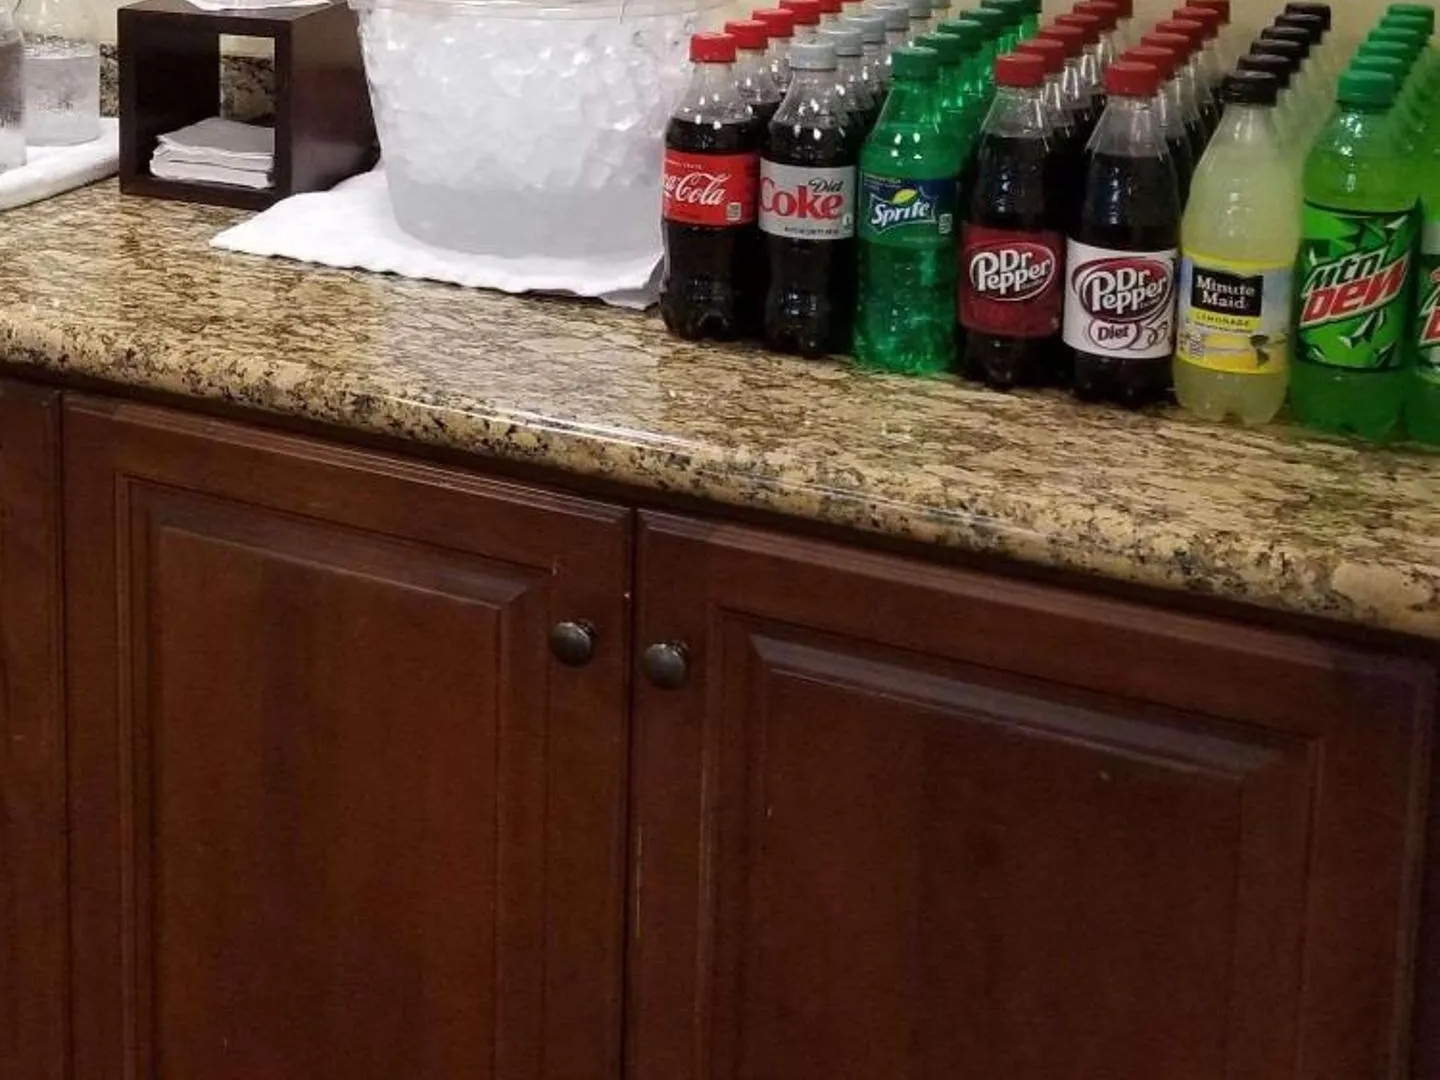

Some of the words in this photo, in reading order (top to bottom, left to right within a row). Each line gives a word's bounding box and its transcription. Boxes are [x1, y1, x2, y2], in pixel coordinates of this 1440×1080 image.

[808, 177, 844, 193] Diet
[759, 176, 846, 220] Coke
[871, 199, 930, 227] Sprite
[1000, 250, 1033, 271] Dr
[970, 251, 1052, 295] Pepper
[1116, 268, 1151, 290] Dr
[1082, 271, 1167, 315] Pepper
[1195, 275, 1256, 296] Minute
[1201, 290, 1246, 309] Maid
[1097, 325, 1129, 341] Diet
